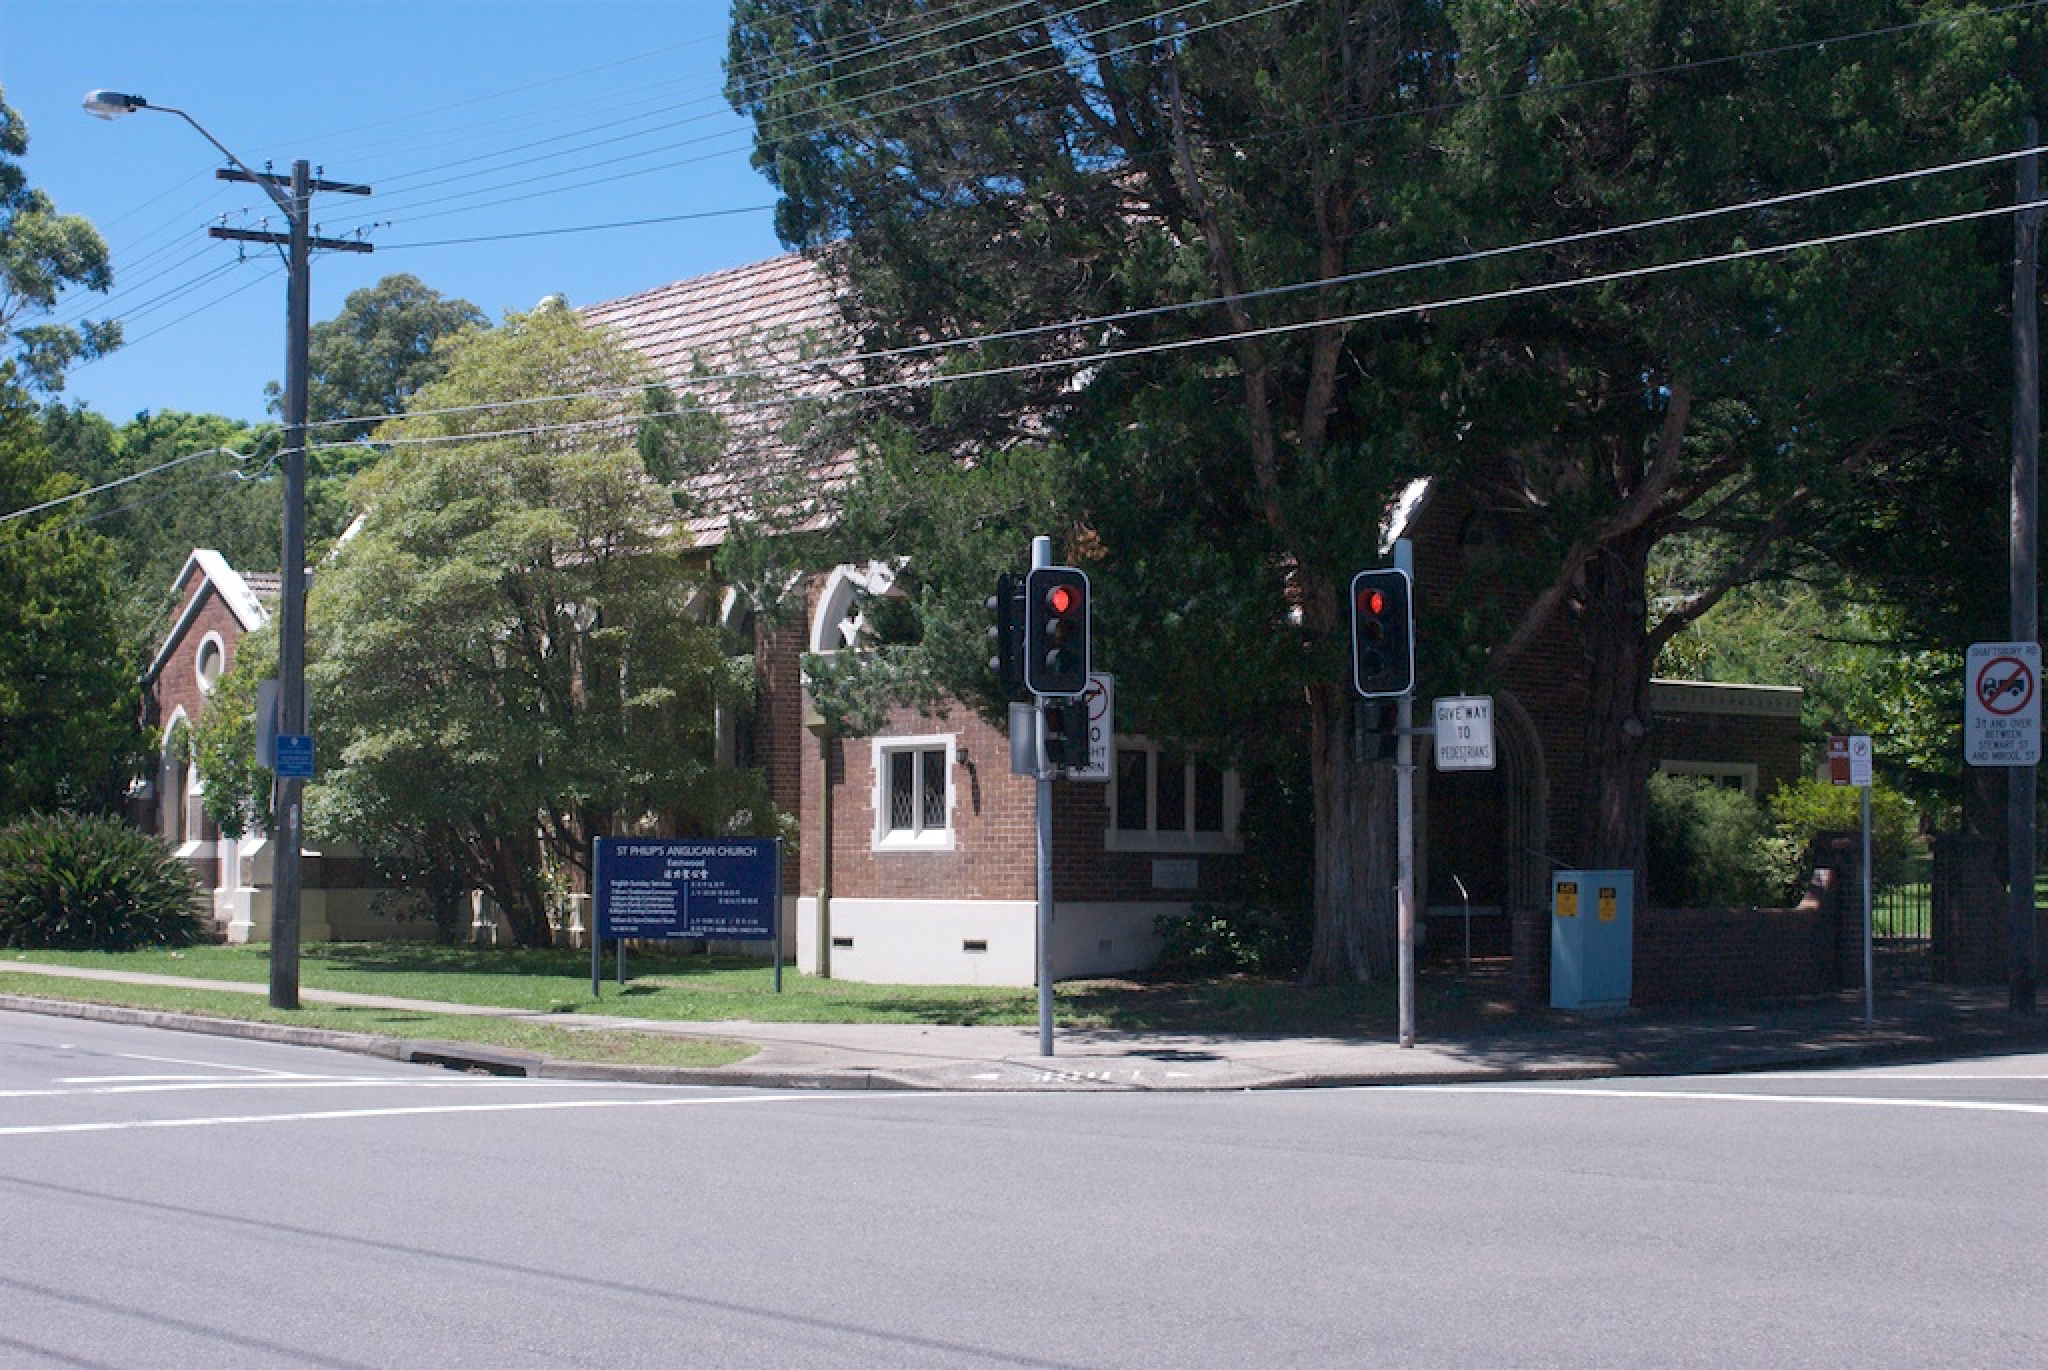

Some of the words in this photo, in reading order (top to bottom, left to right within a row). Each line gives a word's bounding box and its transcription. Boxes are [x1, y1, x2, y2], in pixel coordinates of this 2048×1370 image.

[1971, 647, 2022, 656] SHAFTSBURY
[2026, 645, 2037, 656] RD
[1438, 707, 1462, 720] GIVE
[1466, 706, 1487, 718] WAY
[1990, 718, 2007, 729] AND
[2010, 718, 2032, 728] OVER
[1457, 725, 1471, 740] TO
[1985, 729, 2022, 739] BETWEEN
[1978, 739, 2015, 750] STEWART
[2018, 739, 2029, 749] ST
[1441, 744, 1489, 760] PEDESTRIANS
[1972, 751, 1989, 761] AND
[2025, 750, 2036, 761] ST
[616, 845, 628, 856] ST
[666, 845, 715, 856] ANGLICAN
[717, 845, 757, 856] CHURCH
[667, 858, 705, 867] Eastwood
